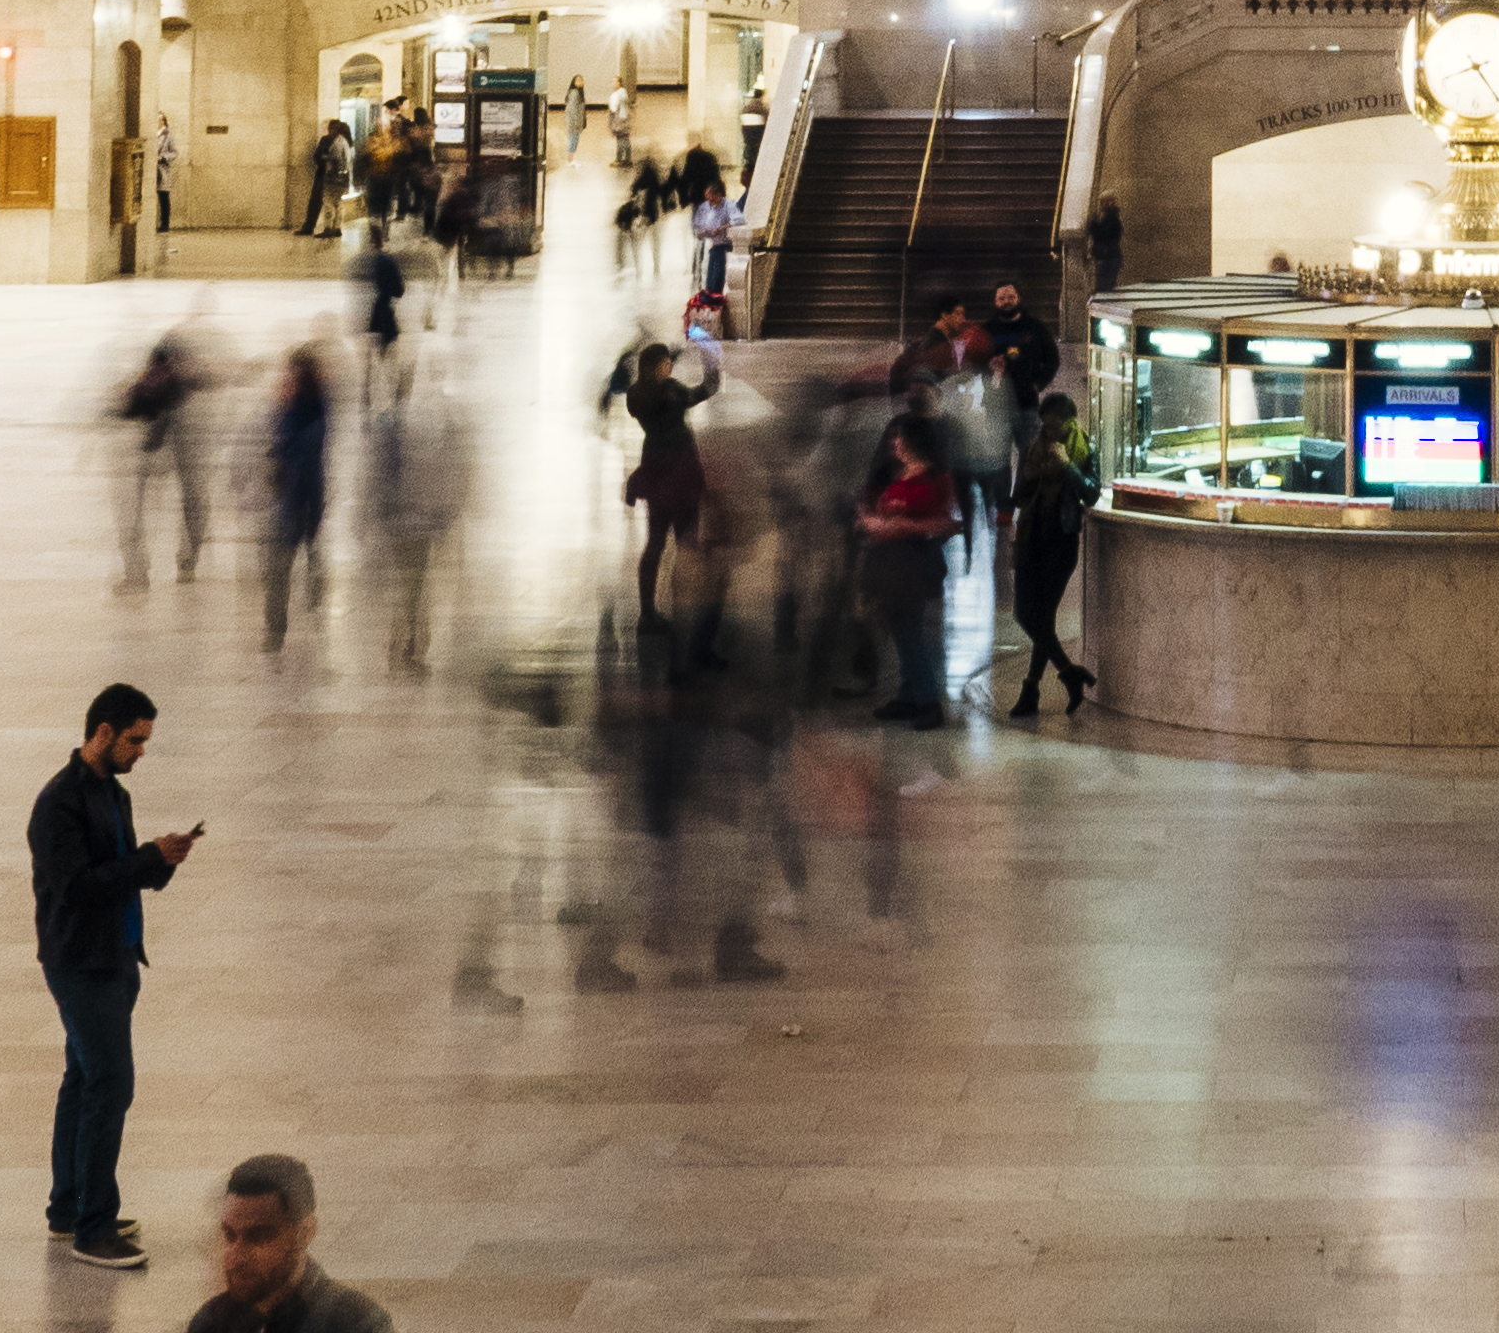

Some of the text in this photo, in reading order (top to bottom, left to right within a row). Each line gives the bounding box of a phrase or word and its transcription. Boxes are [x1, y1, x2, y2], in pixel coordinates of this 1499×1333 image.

[1256, 102, 1323, 132] TRACKS
[1325, 100, 1350, 116] 100
[1355, 94, 1378, 111] TO
[1391, 389, 1455, 403] ARRIVALS
